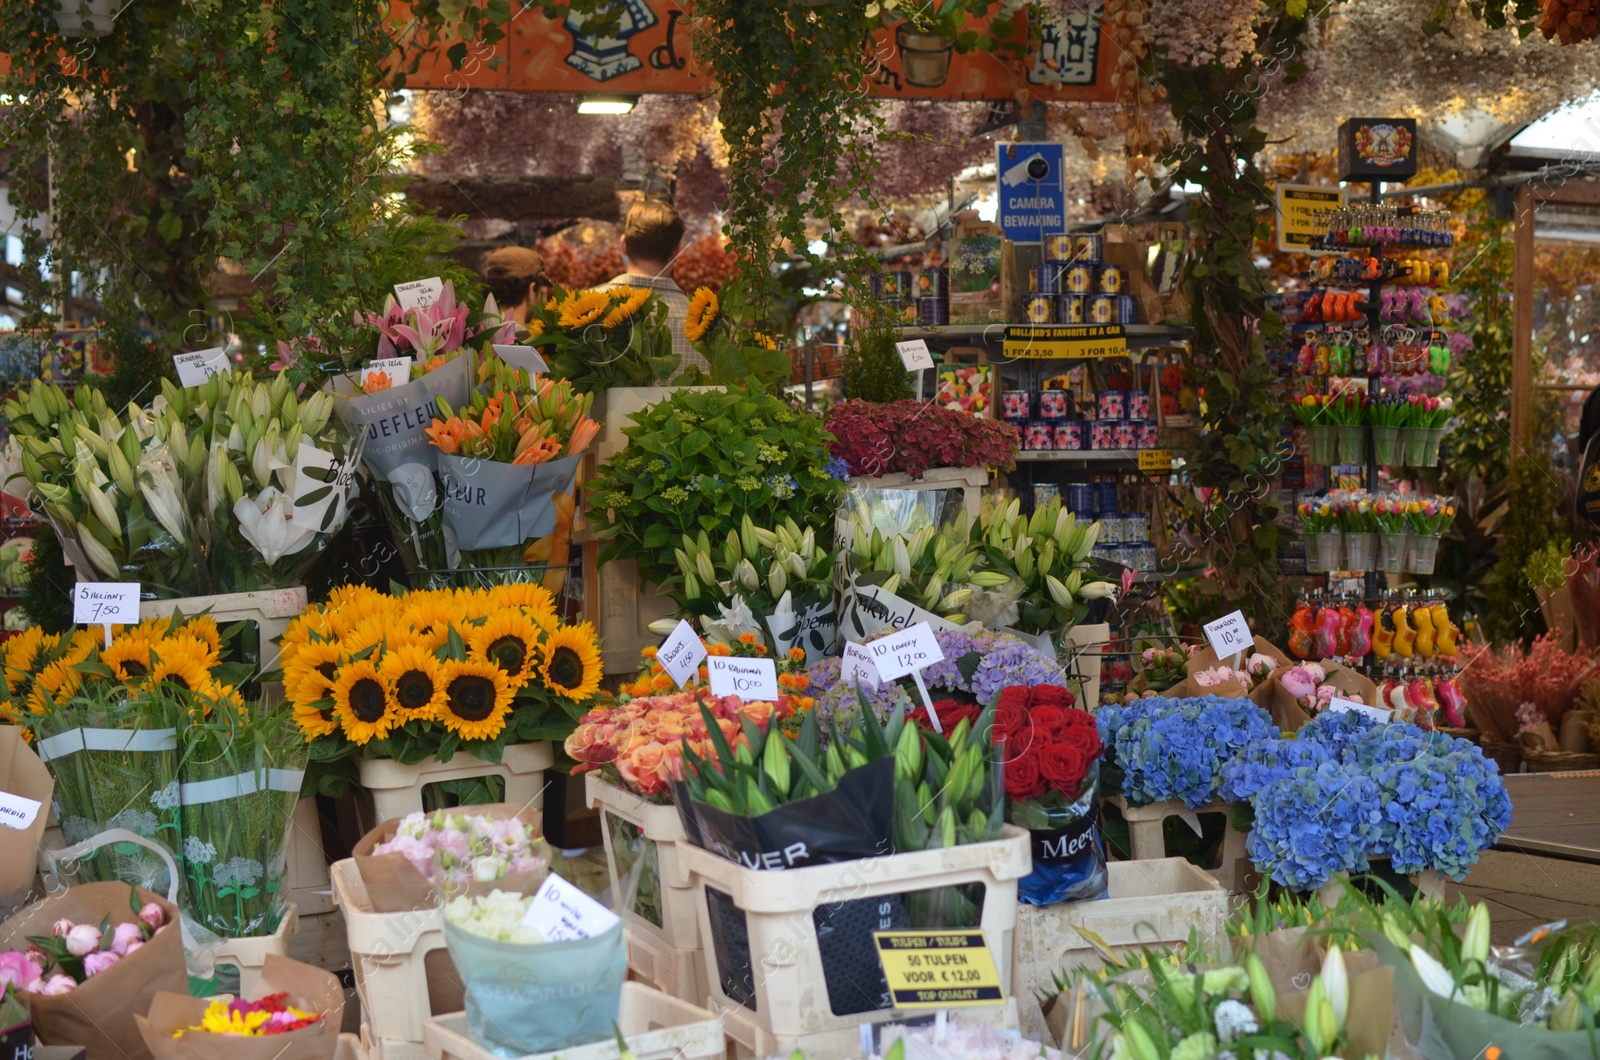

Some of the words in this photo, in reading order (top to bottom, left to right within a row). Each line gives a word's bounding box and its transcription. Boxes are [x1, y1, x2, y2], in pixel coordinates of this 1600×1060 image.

[1009, 197, 1055, 210] CAMERA
[1004, 215, 1062, 228] BEWAKING
[1010, 327, 1051, 338] HOLLAND'S
[1053, 327, 1088, 337] FAVORITE
[1089, 327, 1097, 336] IN
[1098, 327, 1105, 336] A
[1106, 325, 1121, 335] CAN
[1012, 348, 1031, 357] FOR
[1034, 349, 1054, 358] 3,50
[1087, 348, 1105, 356] FOR
[360, 401, 394, 416] LILIES
[396, 396, 409, 407] BY
[384, 432, 430, 454] ORIGINAL
[445, 480, 486, 506] LEUR
[80, 587, 90, 599] 5
[872, 644, 887, 657] 10
[713, 659, 726, 670] 10
[740, 841, 810, 870] VER
[544, 883, 561, 903] 10
[890, 937, 927, 948] TULPEN
[935, 936, 968, 947] TULIPS
[907, 955, 921, 966] 50
[923, 954, 968, 966] TULPEN
[903, 971, 936, 983] VOOR
[951, 970, 981, 983] 12,00
[917, 991, 937, 1002] TOP
[938, 989, 979, 1001] QUALITY
